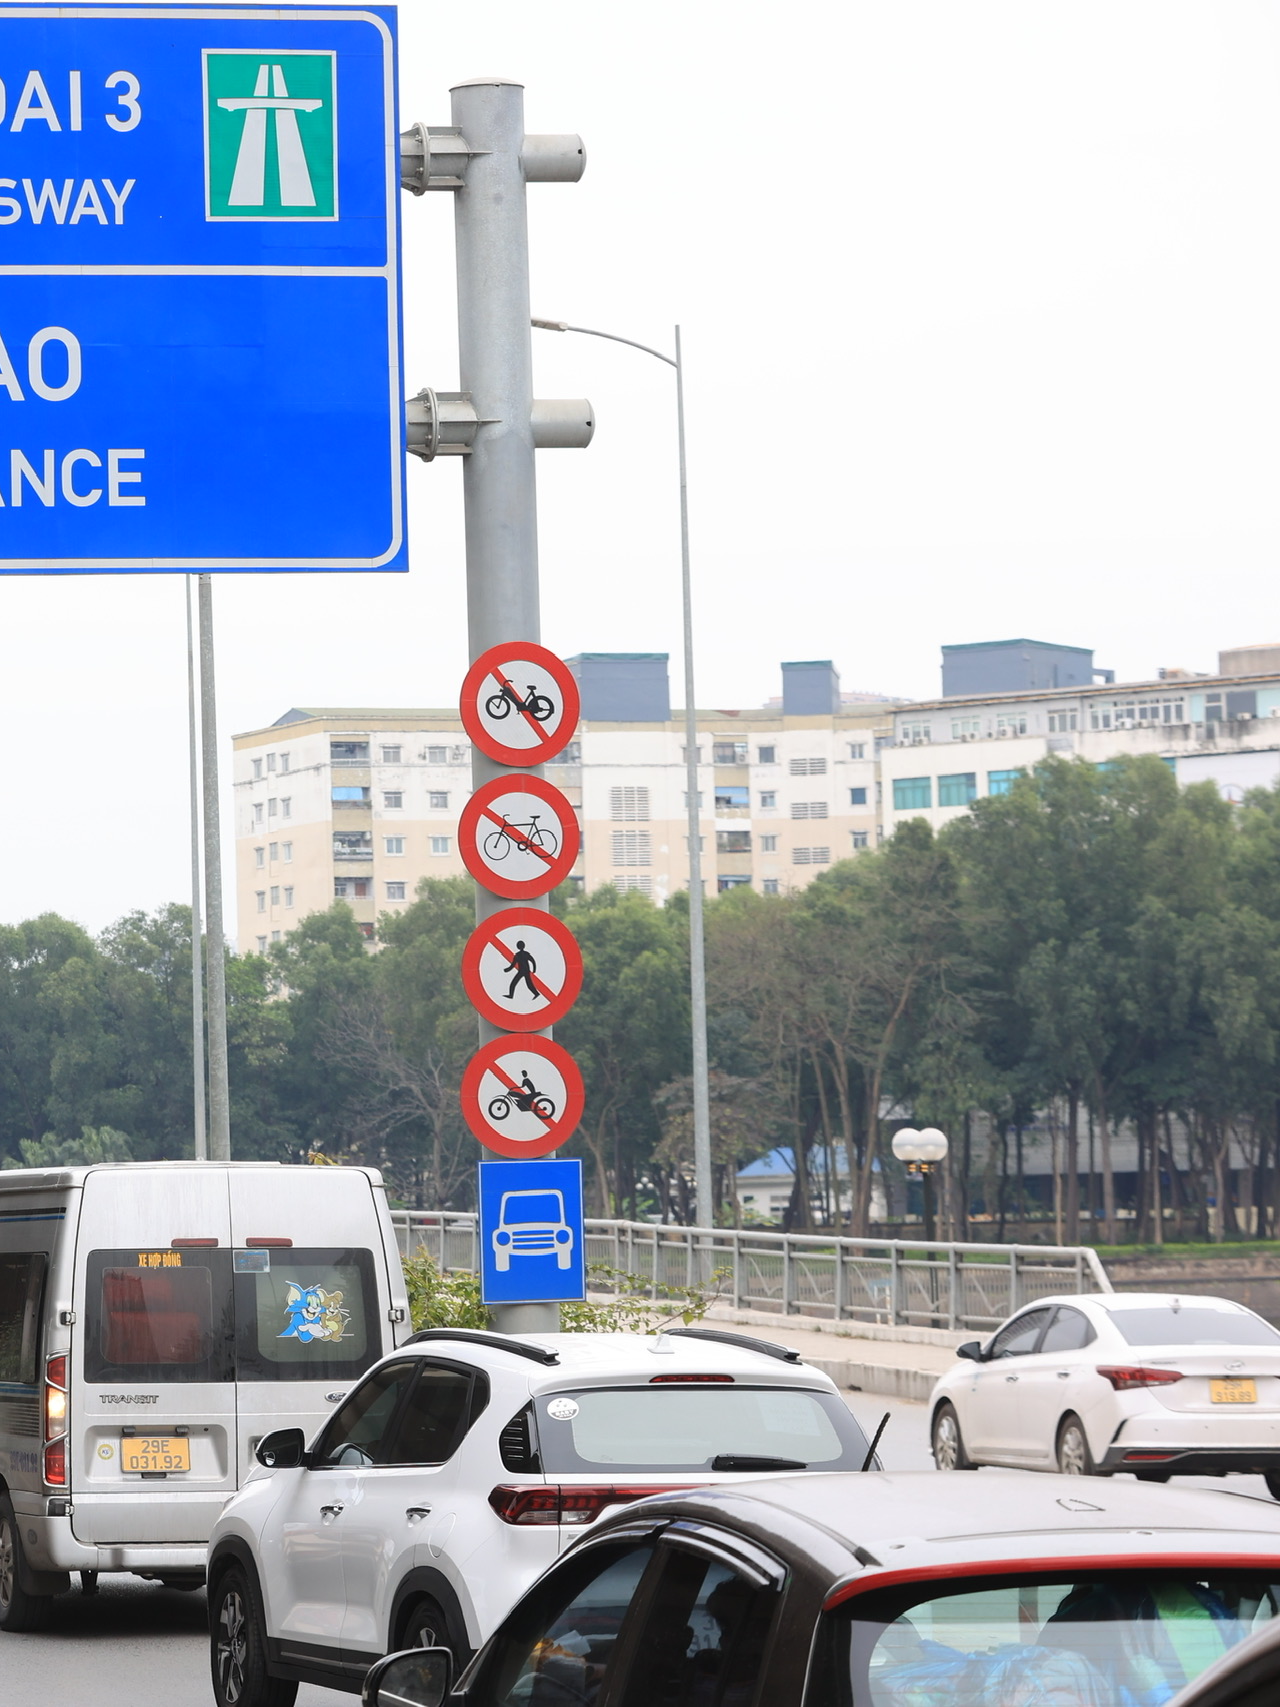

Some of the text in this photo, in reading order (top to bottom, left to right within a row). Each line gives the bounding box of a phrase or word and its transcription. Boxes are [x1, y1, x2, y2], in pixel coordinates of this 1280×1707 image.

[105, 71, 142, 132] 3
[138, 1253, 148, 1268] XE
[99, 1394, 160, 1405] TRANSIT
[141, 1440, 170, 1454] 29E
[129, 1455, 183, 1470] 031.92
